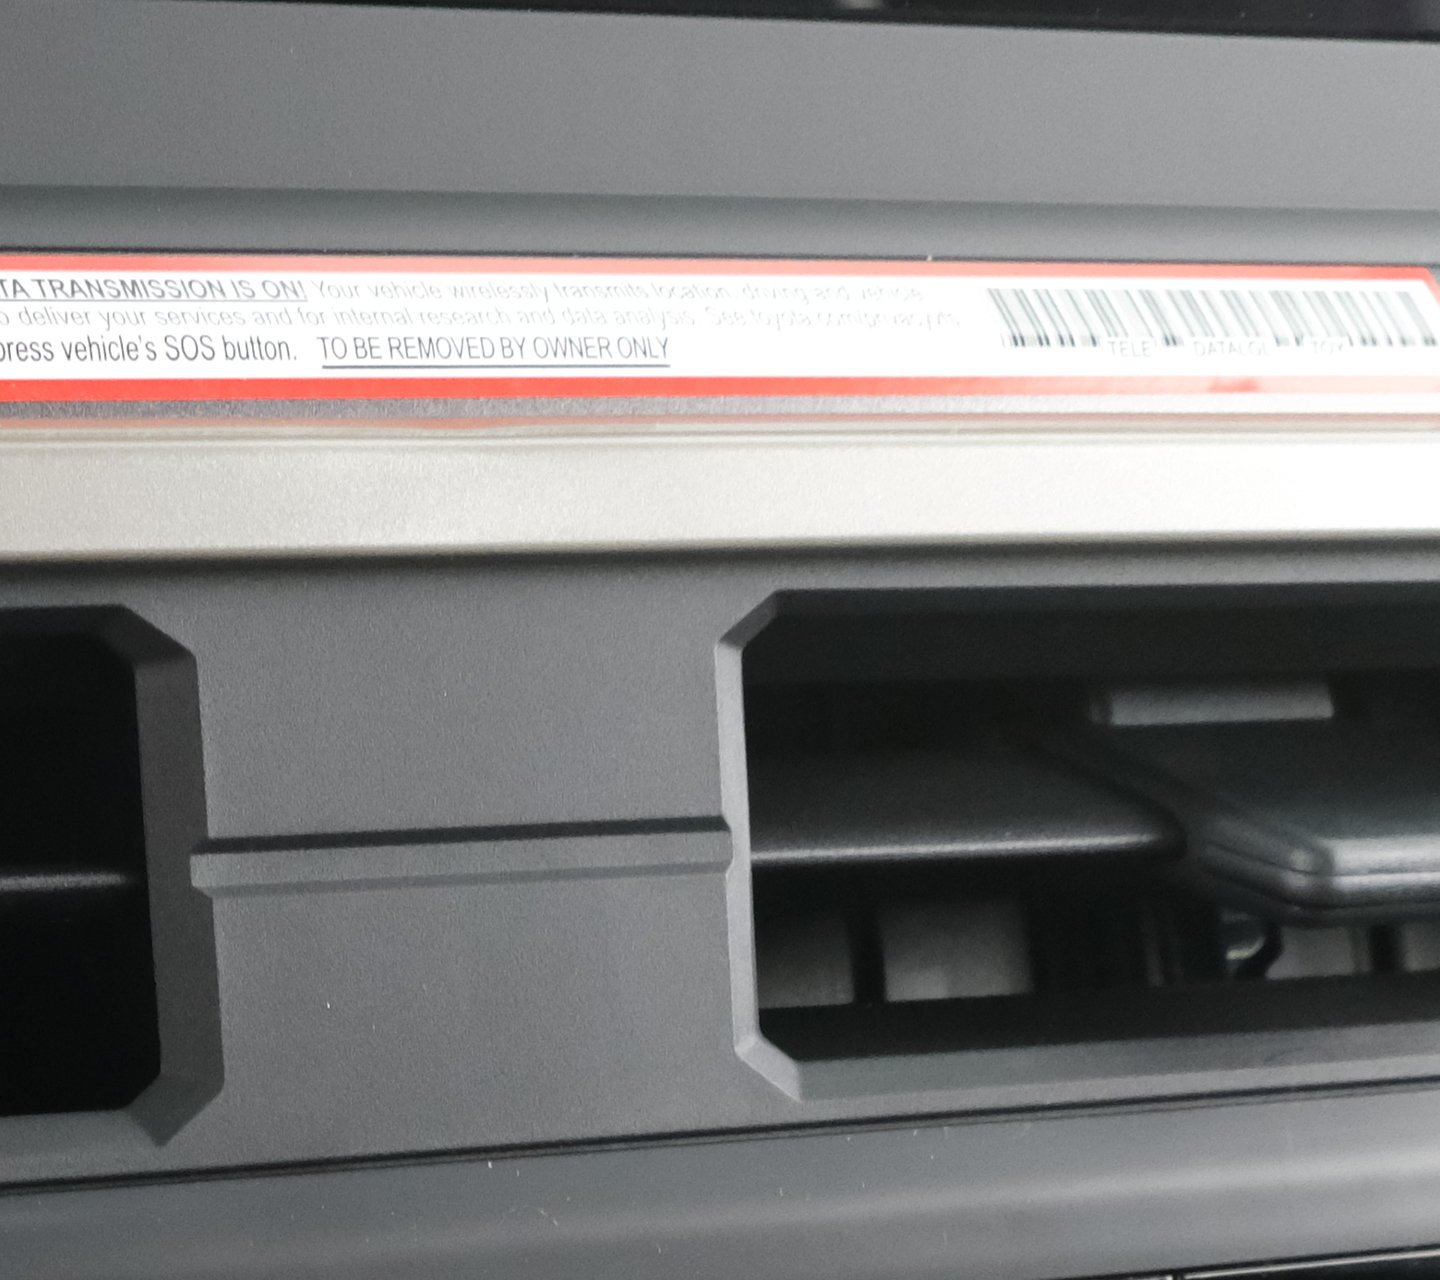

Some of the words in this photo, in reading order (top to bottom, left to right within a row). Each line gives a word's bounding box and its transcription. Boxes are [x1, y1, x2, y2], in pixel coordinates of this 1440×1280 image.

[30, 278, 226, 299] TRANSMISSION
[230, 279, 256, 299] IS
[261, 279, 307, 300] ON!
[310, 280, 361, 300] Your
[366, 281, 443, 300] vehicle
[447, 281, 549, 304] wirelessly
[18, 306, 91, 326] deliver
[98, 308, 147, 331] your
[154, 307, 246, 327] services
[251, 307, 293, 327] and
[296, 307, 327, 327] for
[332, 307, 414, 327] internal
[419, 307, 511, 327] research
[515, 307, 557, 327] and
[61, 335, 158, 362] vehicle's
[163, 335, 217, 362] SOS
[222, 335, 298, 362] button.
[315, 336, 349, 361] TO
[352, 336, 384, 361] BE
[386, 336, 496, 360] REMOVED
[498, 336, 527, 360] BY
[531, 336, 614, 360] OWNER
[616, 335, 670, 360] ONLY
